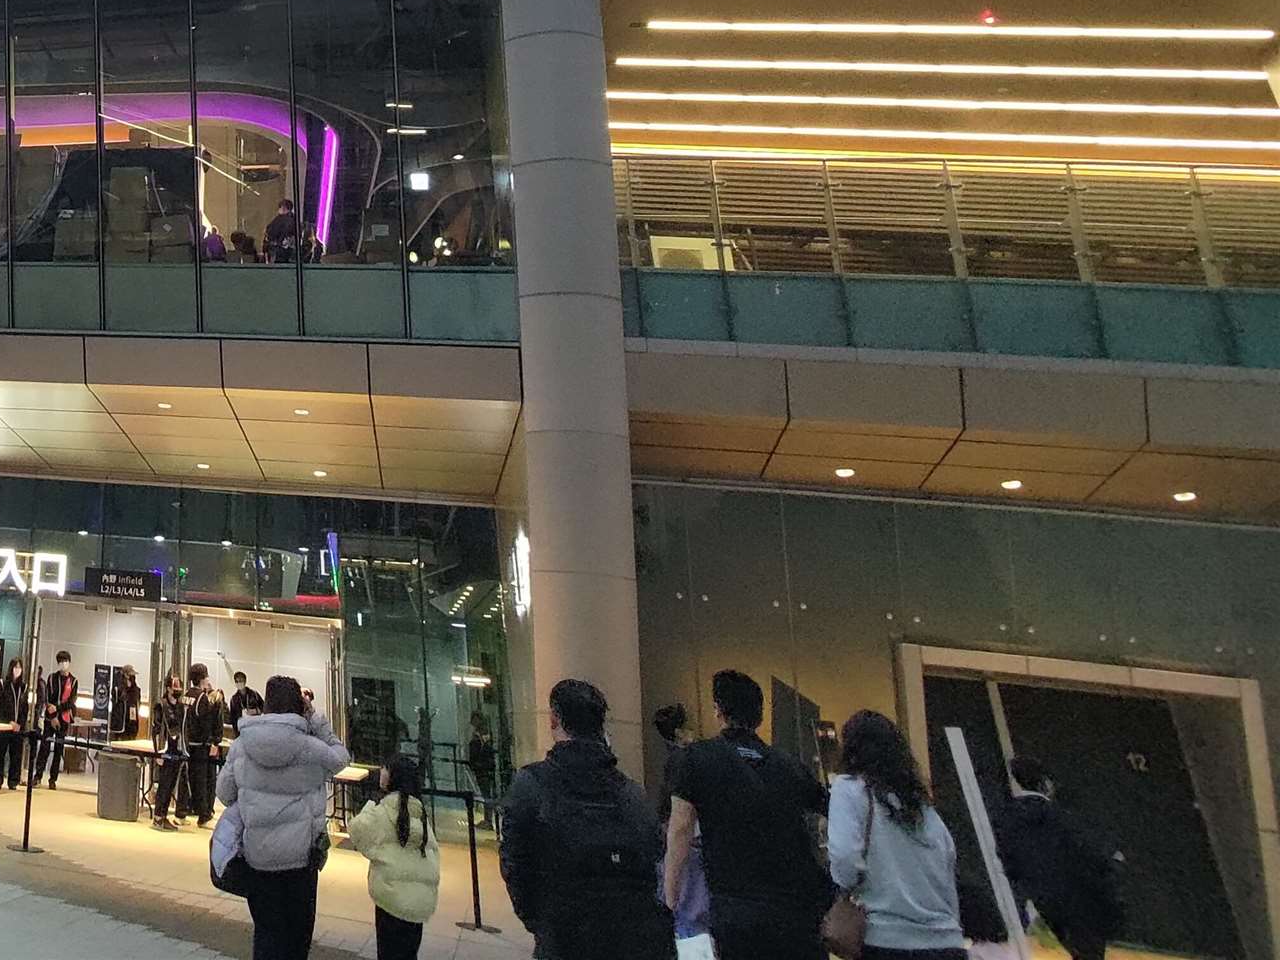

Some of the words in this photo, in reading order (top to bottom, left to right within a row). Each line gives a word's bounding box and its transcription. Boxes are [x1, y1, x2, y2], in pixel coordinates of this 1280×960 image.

[118, 576, 143, 586] Infield
[100, 585, 145, 597] L2/L3/L4/L5
[1126, 751, 1150, 772] 12
